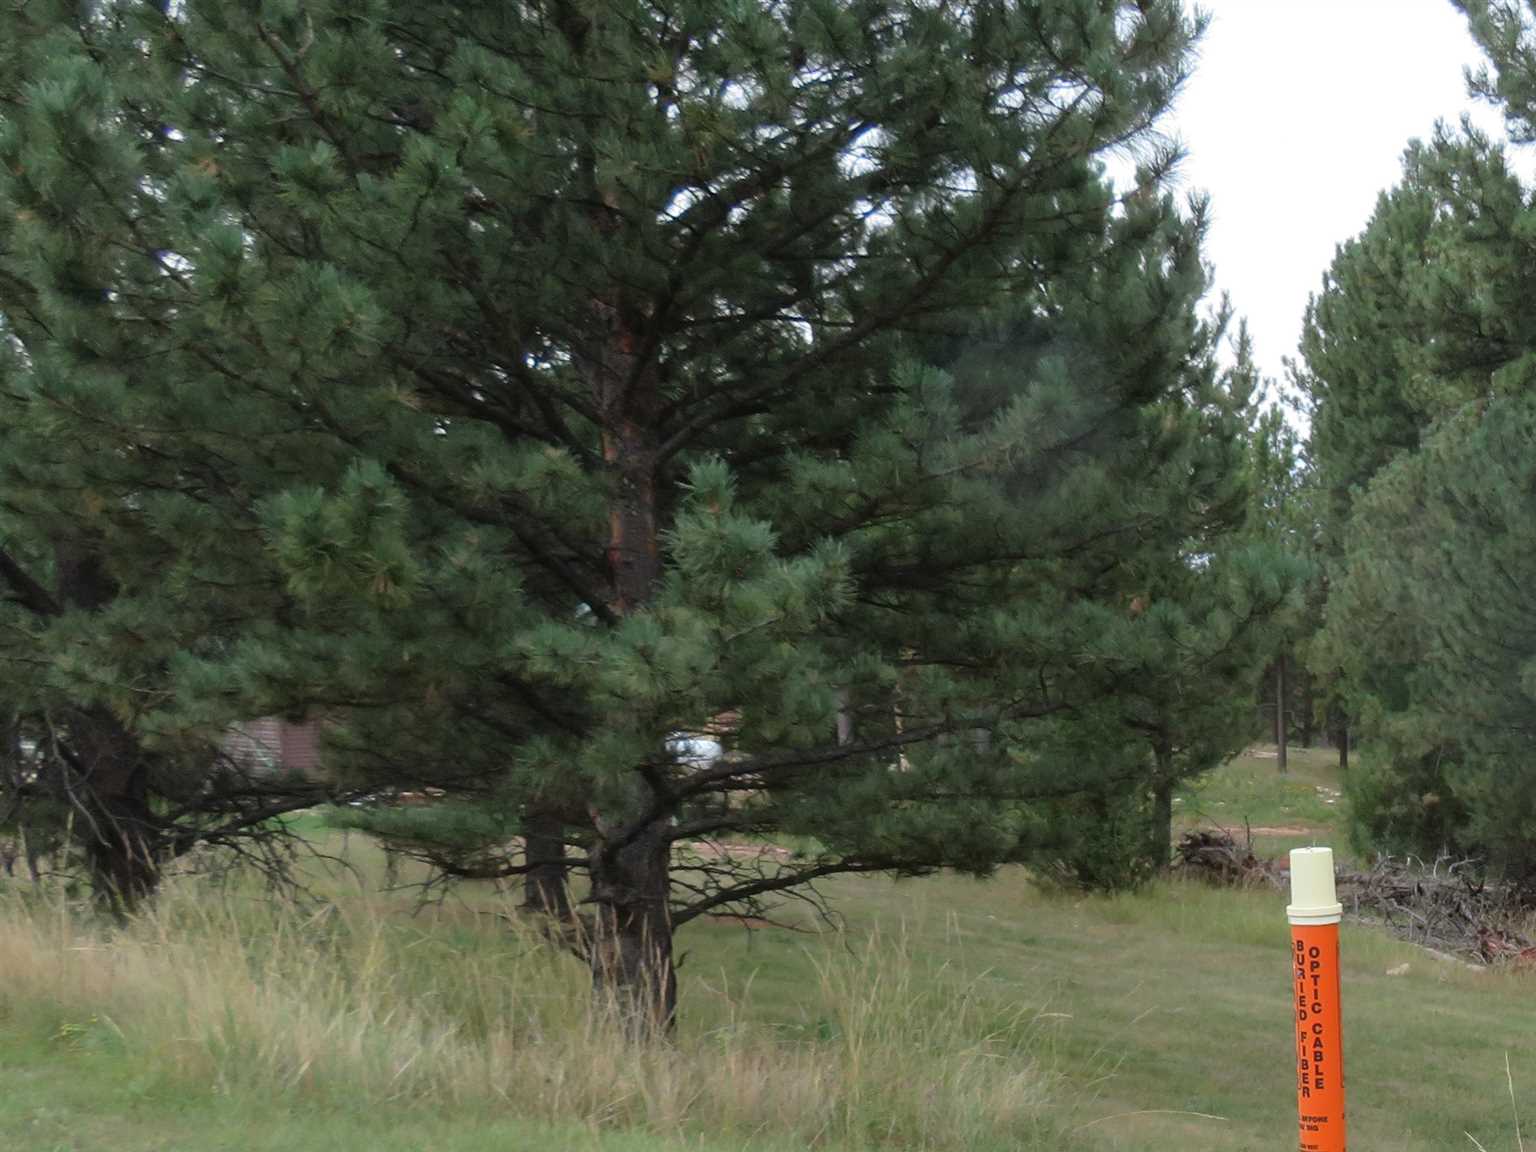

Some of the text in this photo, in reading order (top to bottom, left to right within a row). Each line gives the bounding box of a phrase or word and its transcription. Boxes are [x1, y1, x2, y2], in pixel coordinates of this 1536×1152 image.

[1296, 940, 1310, 1098] BURIED FIBER
[1309, 946, 1324, 1089] OPTIC CABLE
